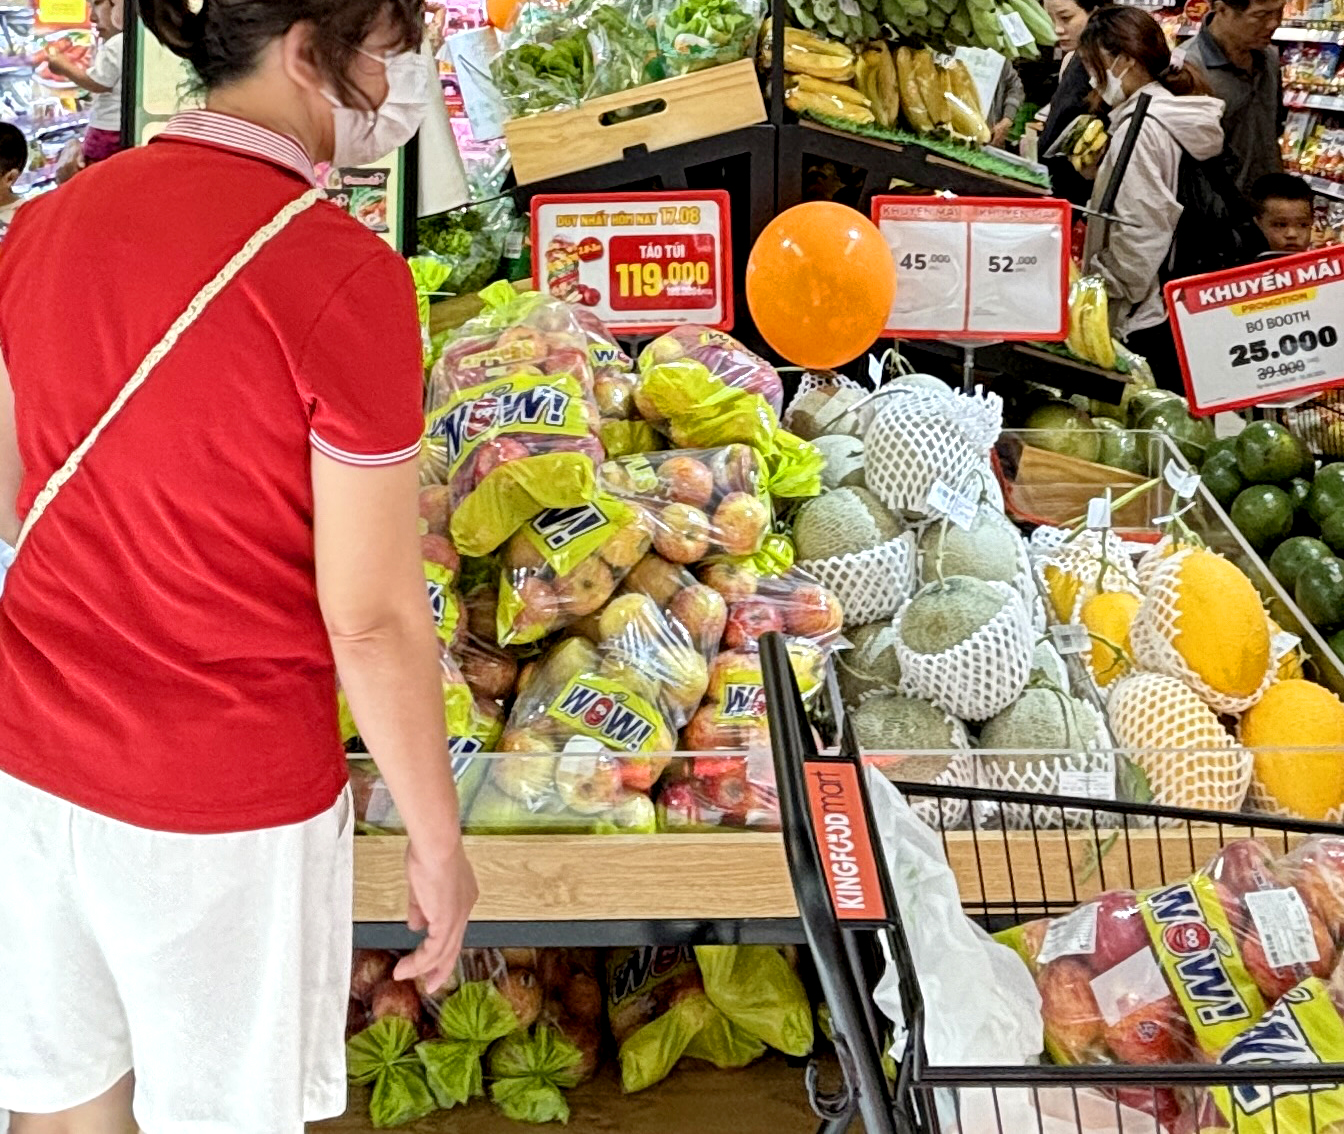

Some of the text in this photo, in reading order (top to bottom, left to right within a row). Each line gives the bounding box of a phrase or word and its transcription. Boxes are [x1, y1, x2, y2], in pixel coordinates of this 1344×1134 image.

[659, 205, 701, 225] 17.08
[639, 241, 686, 259] TÁO TÚI
[615, 261, 710, 297] 119.000
[1199, 258, 1343, 306] KHUYẾN MÃI
[1241, 292, 1309, 314] PROMOTION
[1267, 310, 1311, 330] BOOTH
[1229, 325, 1339, 368] 25.000
[553, 681, 657, 754] WOW!
[1145, 881, 1253, 1028] WOW!
